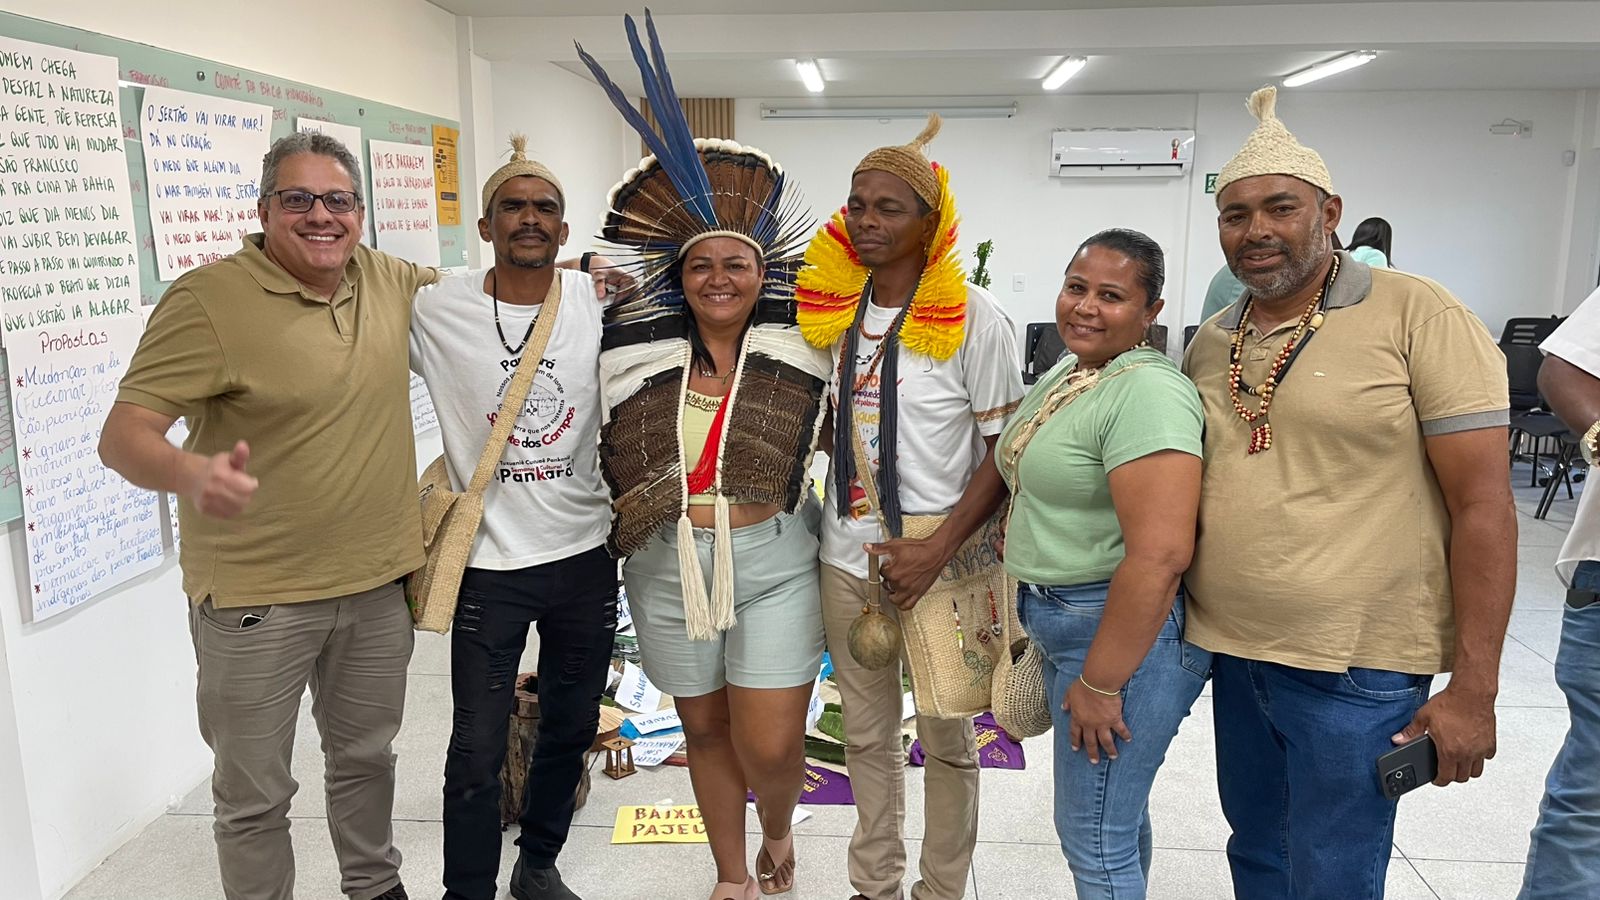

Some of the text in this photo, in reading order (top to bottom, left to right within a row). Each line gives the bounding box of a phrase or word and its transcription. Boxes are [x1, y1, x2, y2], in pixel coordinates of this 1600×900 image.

[41, 57, 76, 79] CHEGA
[2, 77, 114, 107] DESFAZ A NATUREZA
[55, 106, 72, 126] PÕE
[74, 111, 118, 128] REPRESA
[148, 104, 154, 121] O
[158, 104, 188, 124] SERTÃO
[196, 111, 208, 125] VAI
[215, 113, 236, 128] VIRAR
[242, 114, 263, 132] MAR!
[10, 130, 30, 149] QUE
[35, 134, 59, 150] TUDO
[63, 135, 80, 152] VAI
[87, 136, 123, 153] MUDAR
[150, 130, 211, 151] DÁ NO CORAÇÃO
[24, 156, 79, 174] FRANCISCO
[154, 158, 241, 175] O MEDO QUE ALGUM DIA
[12, 180, 31, 197] PRA
[36, 178, 62, 195] CIMA
[65, 178, 78, 193] DA
[82, 176, 115, 193] BAHIA
[156, 183, 161, 198] O
[164, 183, 181, 199] MAR
[216, 185, 231, 199] VIRE
[19, 206, 39, 224] QUE
[44, 205, 61, 223] DIA
[65, 206, 97, 222] MENOS
[101, 204, 120, 221] DIA
[160, 211, 173, 224] VAI
[177, 209, 200, 224] VIRAR
[204, 205, 224, 223] MAR!
[227, 207, 235, 223] DÁ
[238, 210, 246, 221] NO
[1, 234, 18, 250] VAI
[22, 232, 53, 250] SUBIR
[56, 230, 80, 248] BEM
[83, 230, 132, 248] DEVAGAR
[165, 233, 170, 246] O
[173, 231, 192, 245] MEDO
[195, 230, 207, 243] QUE
[212, 229, 233, 242] ALGUM
[9, 259, 31, 276] PASSO
[34, 257, 40, 273] A
[42, 256, 65, 272] PASSO
[68, 256, 80, 271] VAI
[128, 253, 136, 267] A
[168, 253, 173, 270] O
[177, 253, 195, 270] MAR
[1, 274, 131, 303] PROFECIA DO BEATO QUE DIZIA
[5, 312, 26, 332] QUE
[29, 311, 35, 328] O
[37, 301, 66, 326] SERTÃO
[72, 304, 83, 321] IA
[89, 298, 134, 318] ALAGAR
[25, 363, 87, 388] Mudanças
[521, 406, 575, 448] dos Campos
[541, 423, 551, 432] nos
[500, 462, 574, 483] Pankará
[635, 807, 702, 820] BAIXO
